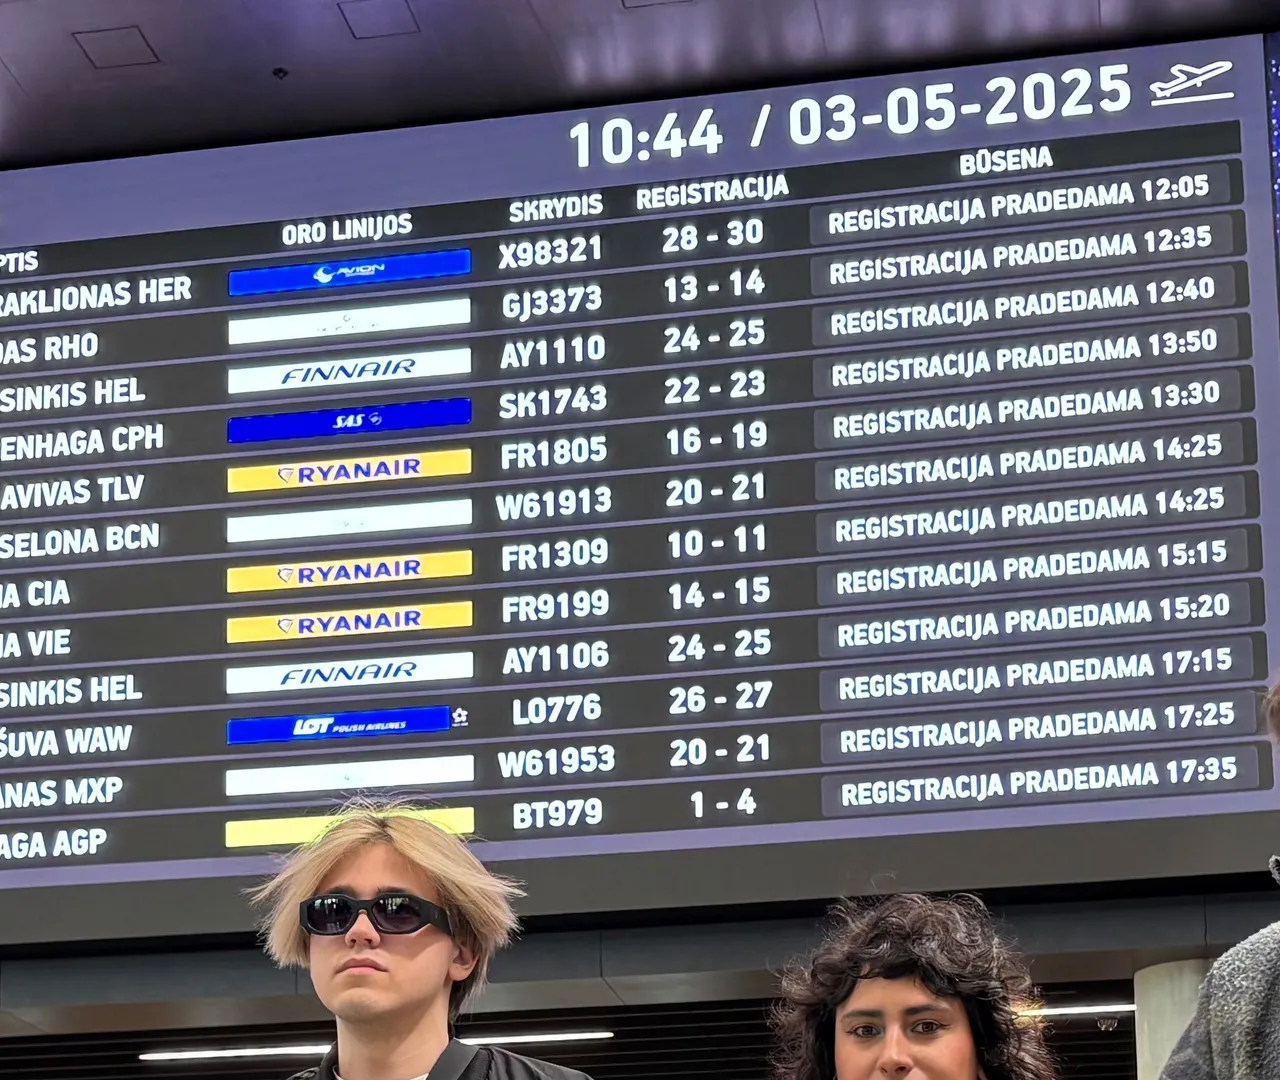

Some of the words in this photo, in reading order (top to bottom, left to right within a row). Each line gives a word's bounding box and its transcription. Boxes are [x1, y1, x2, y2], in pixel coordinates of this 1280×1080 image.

[570, 108, 723, 168] 10:44
[750, 104, 771, 148] /
[789, 63, 1131, 145] 03-05-2025
[509, 193, 604, 223] SKRYDIS
[636, 174, 790, 210] REGISTRACIJA
[828, 197, 986, 235] REGISTRACIJA
[991, 182, 1135, 217] PRADEDAMA
[1141, 174, 1209, 202] 12:05
[282, 221, 326, 246] ORO
[332, 213, 413, 241] LINIJOS
[662, 225, 698, 253] 28
[727, 218, 763, 246] 30
[498, 234, 601, 270] X98321
[139, 275, 192, 304] HER
[502, 285, 602, 323] GJ3373
[44, 332, 98, 361] RHO
[500, 334, 605, 369] AY1110
[832, 350, 991, 387] REGISTRACIJA
[996, 336, 1142, 371] PRADEDAMA
[1148, 328, 1217, 356] 13:50
[281, 358, 417, 386] FINNAIR
[94, 377, 146, 405] HEL
[499, 384, 607, 419] SK1743
[111, 423, 164, 452] CPH
[333, 413, 366, 429] SAS
[501, 435, 607, 470] FR1805
[298, 458, 421, 484] RYANAIR
[0, 478, 91, 511] AVIVAS
[97, 474, 145, 502] TLV
[495, 486, 612, 521] W61913
[106, 522, 159, 551] BCN
[836, 559, 998, 595] REGISTRACIJA
[1003, 546, 1150, 581] PRADEDAMA
[1157, 539, 1227, 568] 15:15
[27, 628, 71, 656] VIE
[502, 640, 609, 675] AY1106
[668, 633, 706, 662] 24
[734, 628, 771, 657] 25
[512, 693, 602, 726] LO776
[64, 724, 133, 754] WAW
[293, 717, 334, 736] LOT
[841, 773, 1004, 807] REGISTRACIJA
[1010, 761, 1160, 795] PRADEDAMA
[1166, 756, 1237, 784] 17:35
[513, 797, 603, 829] BT979
[52, 828, 107, 857] AGP
